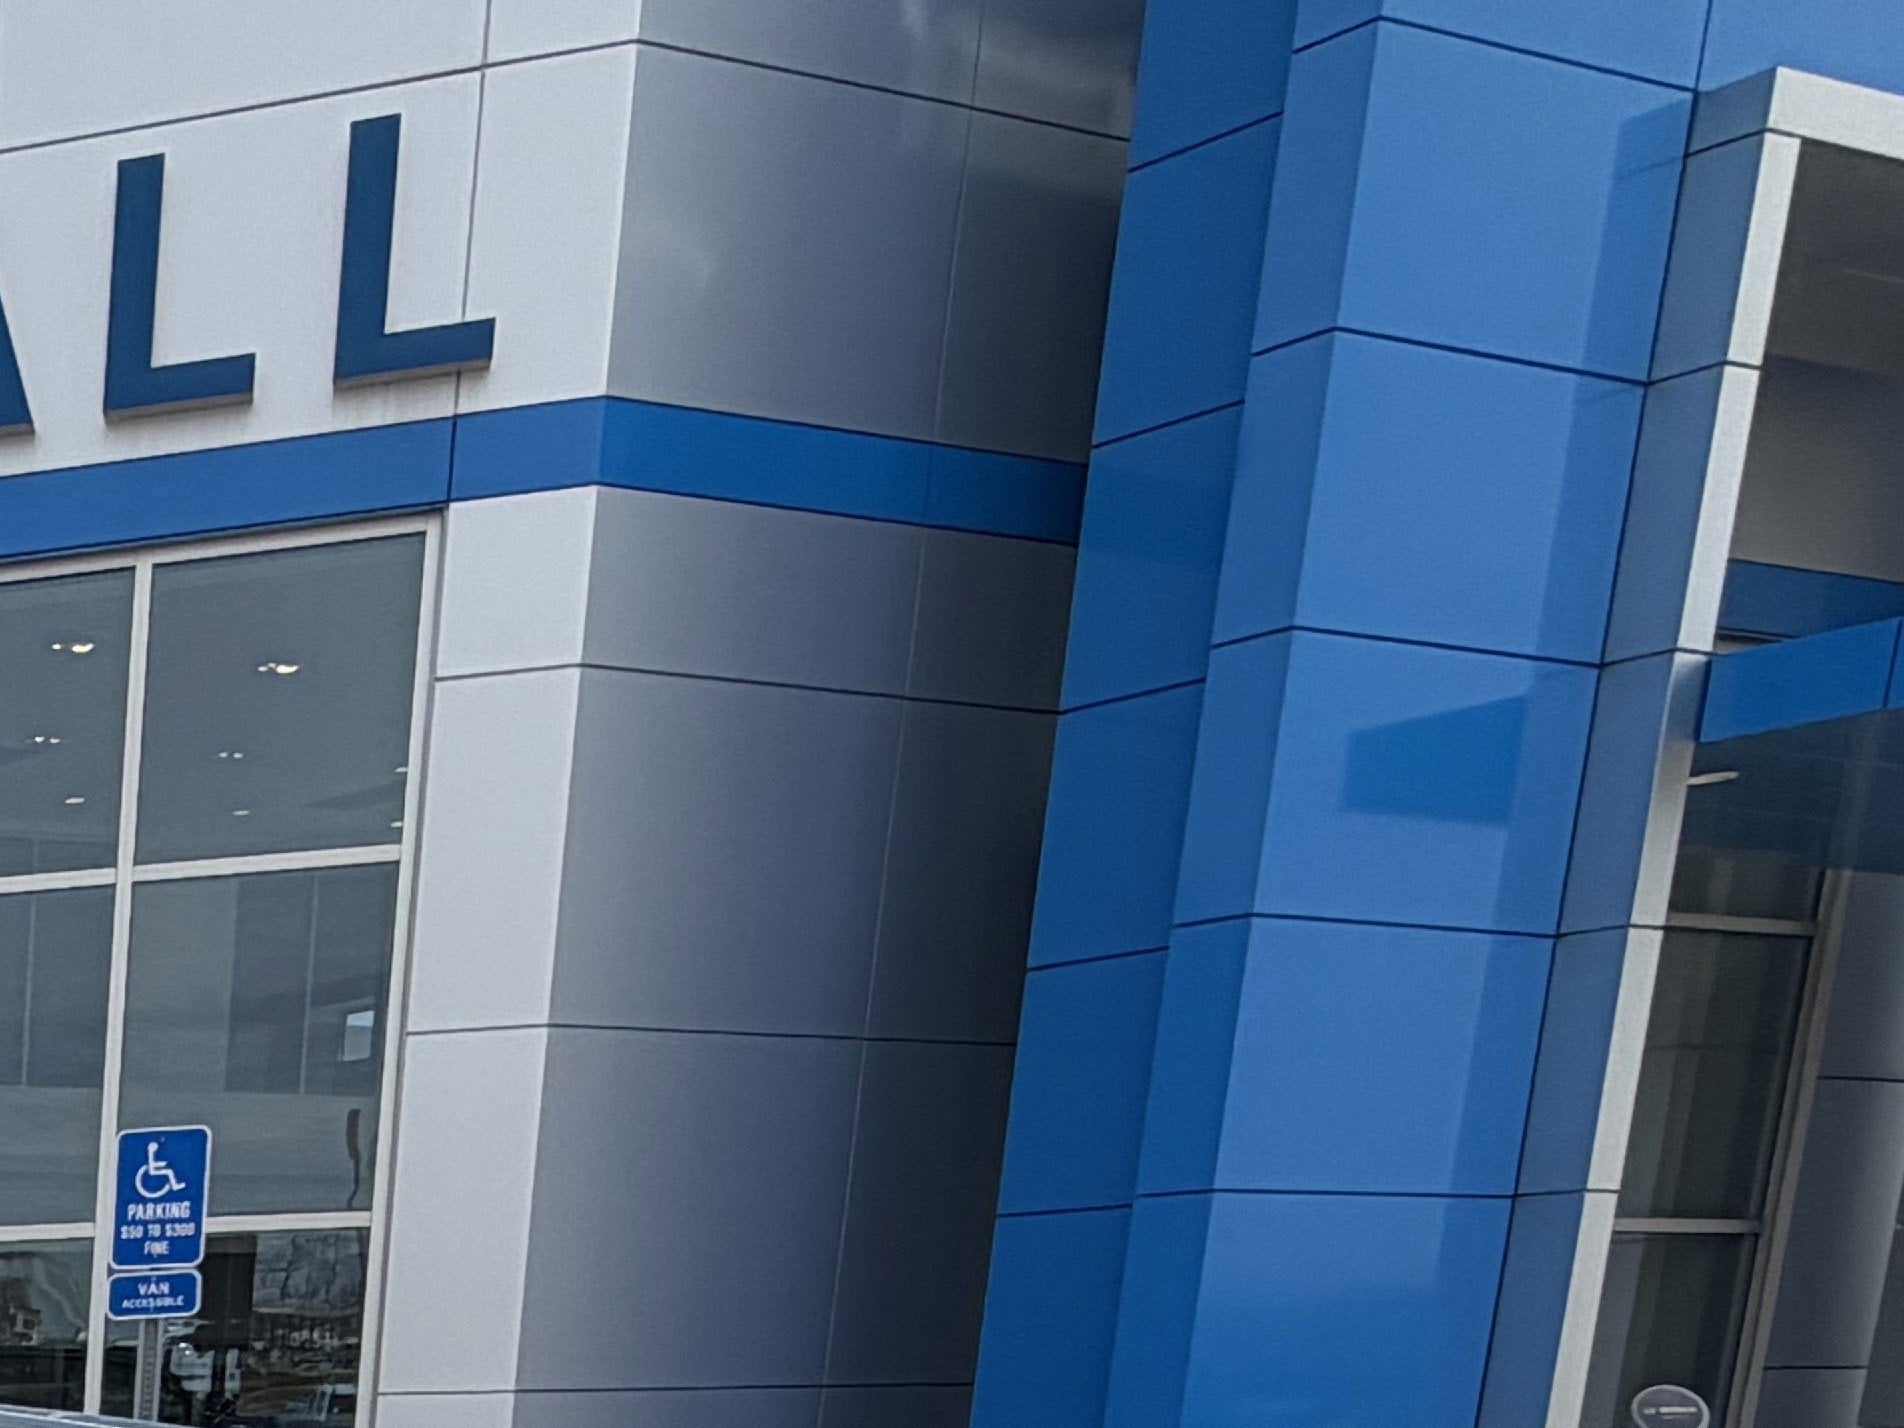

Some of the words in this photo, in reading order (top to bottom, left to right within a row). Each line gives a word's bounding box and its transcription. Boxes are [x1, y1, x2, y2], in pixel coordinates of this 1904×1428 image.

[127, 1201, 191, 1220] PARKING
[147, 1224, 161, 1237] TO
[144, 1241, 169, 1255] FINE
[138, 1282, 169, 1295] VAN
